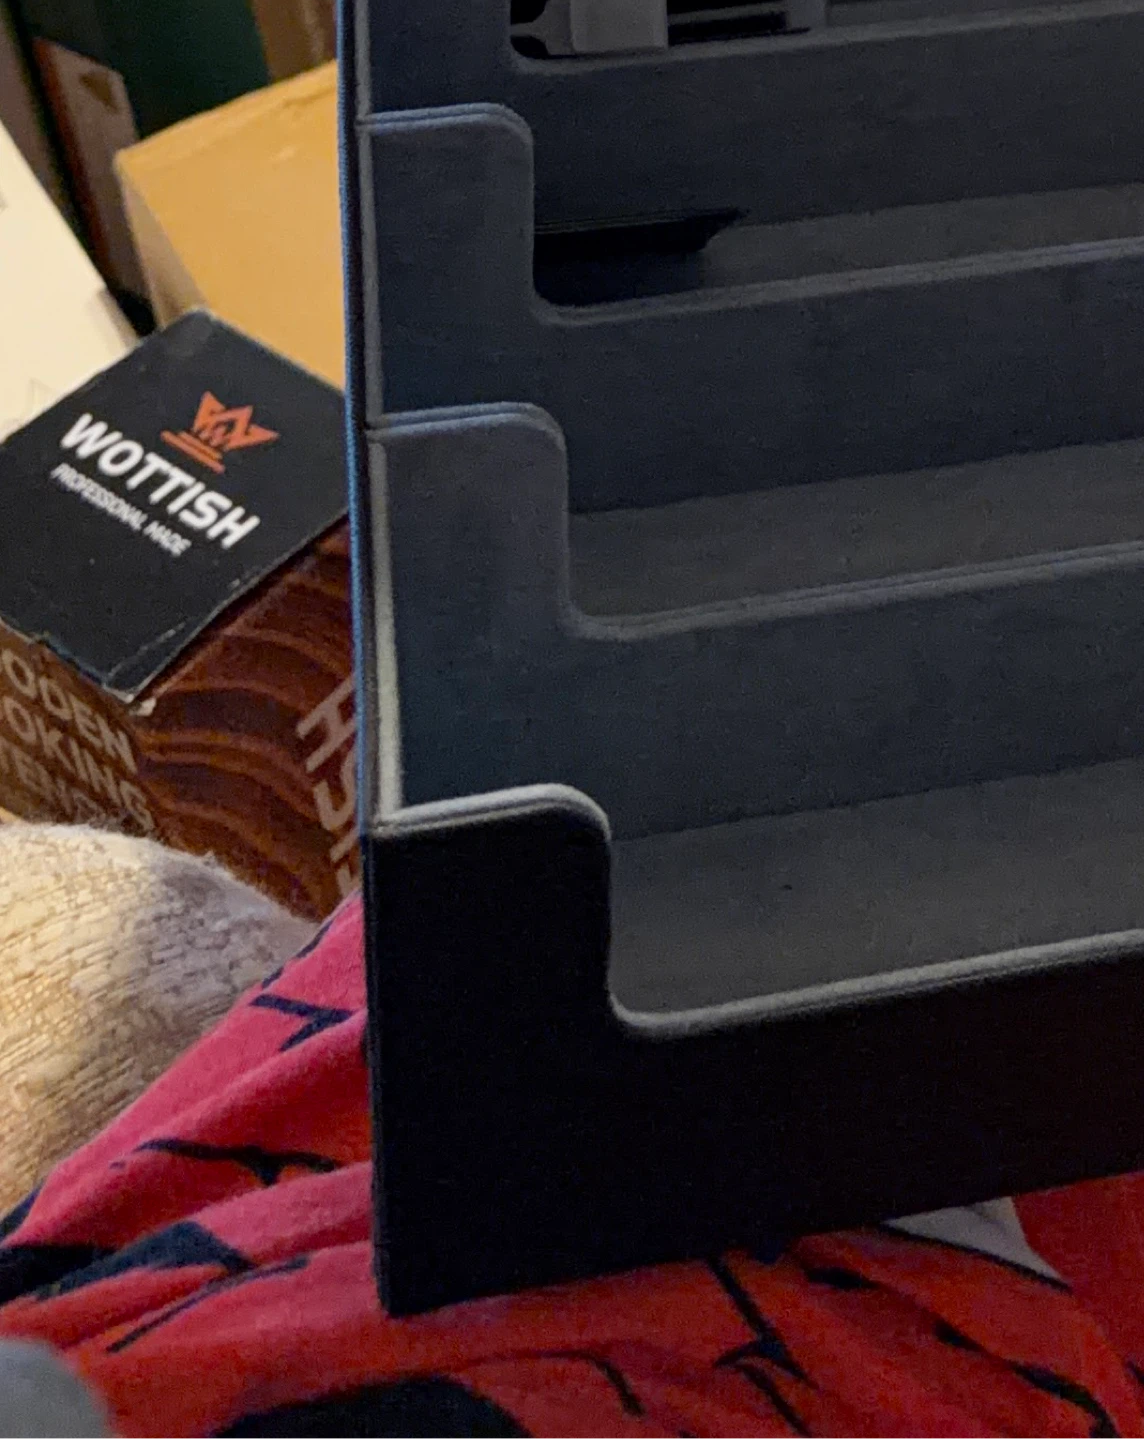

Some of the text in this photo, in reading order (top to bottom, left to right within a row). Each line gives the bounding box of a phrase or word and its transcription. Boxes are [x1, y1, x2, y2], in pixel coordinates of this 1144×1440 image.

[51, 461, 193, 558] PROFESSIONAL MADE
[60, 412, 261, 550] WOTTISH
[0, 649, 137, 775] ODEN
[0, 695, 155, 831] OKING
